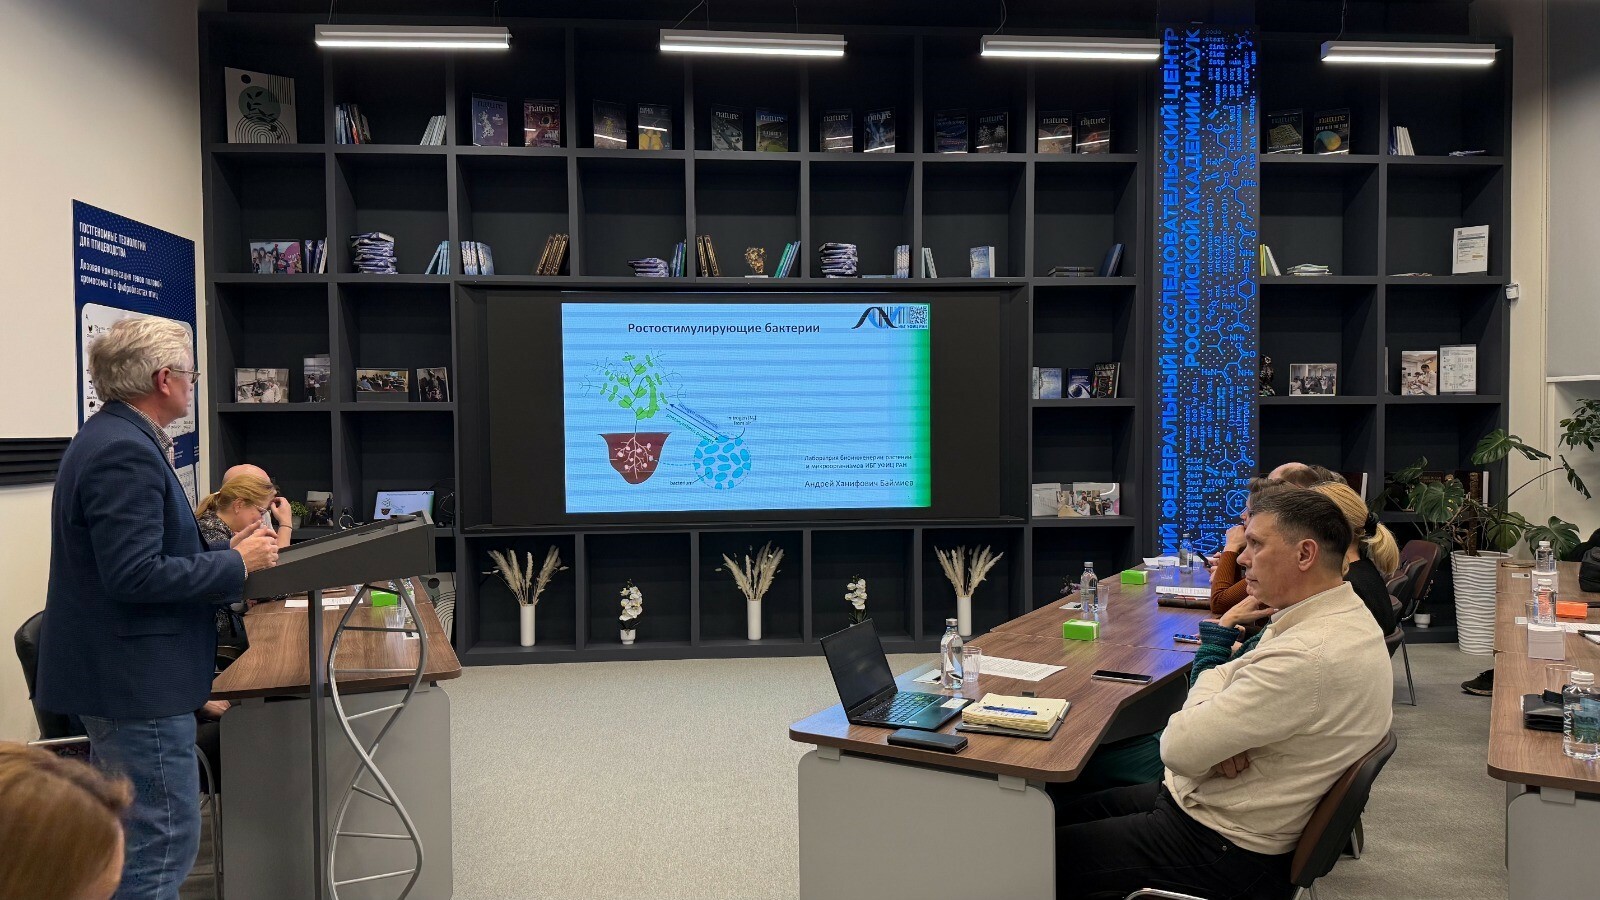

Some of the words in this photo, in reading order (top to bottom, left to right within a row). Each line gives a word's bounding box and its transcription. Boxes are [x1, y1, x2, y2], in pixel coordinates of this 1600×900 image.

[1164, 28, 1180, 98] ЦЕНТР
[1186, 29, 1200, 86] НАУК
[1080, 117, 1106, 126] nature
[1185, 92, 1202, 214] АКАДЕМИИ
[80, 222, 118, 243] ПОСТГЕНОМНЫЕ
[91, 238, 126, 258] ПТИЦЕВОДСТВА
[1160, 105, 1180, 348] ИССЛЕДОВАТЕЛЬСКИЙ
[1182, 220, 1200, 366] РОССИЙСКОЙ
[628, 323, 762, 335] Ростостимулирующие
[765, 323, 820, 335] бактерии
[1158, 355, 1179, 518] ФЕДЕРАЛЬНЫЙ
[805, 480, 834, 488] Андрей
